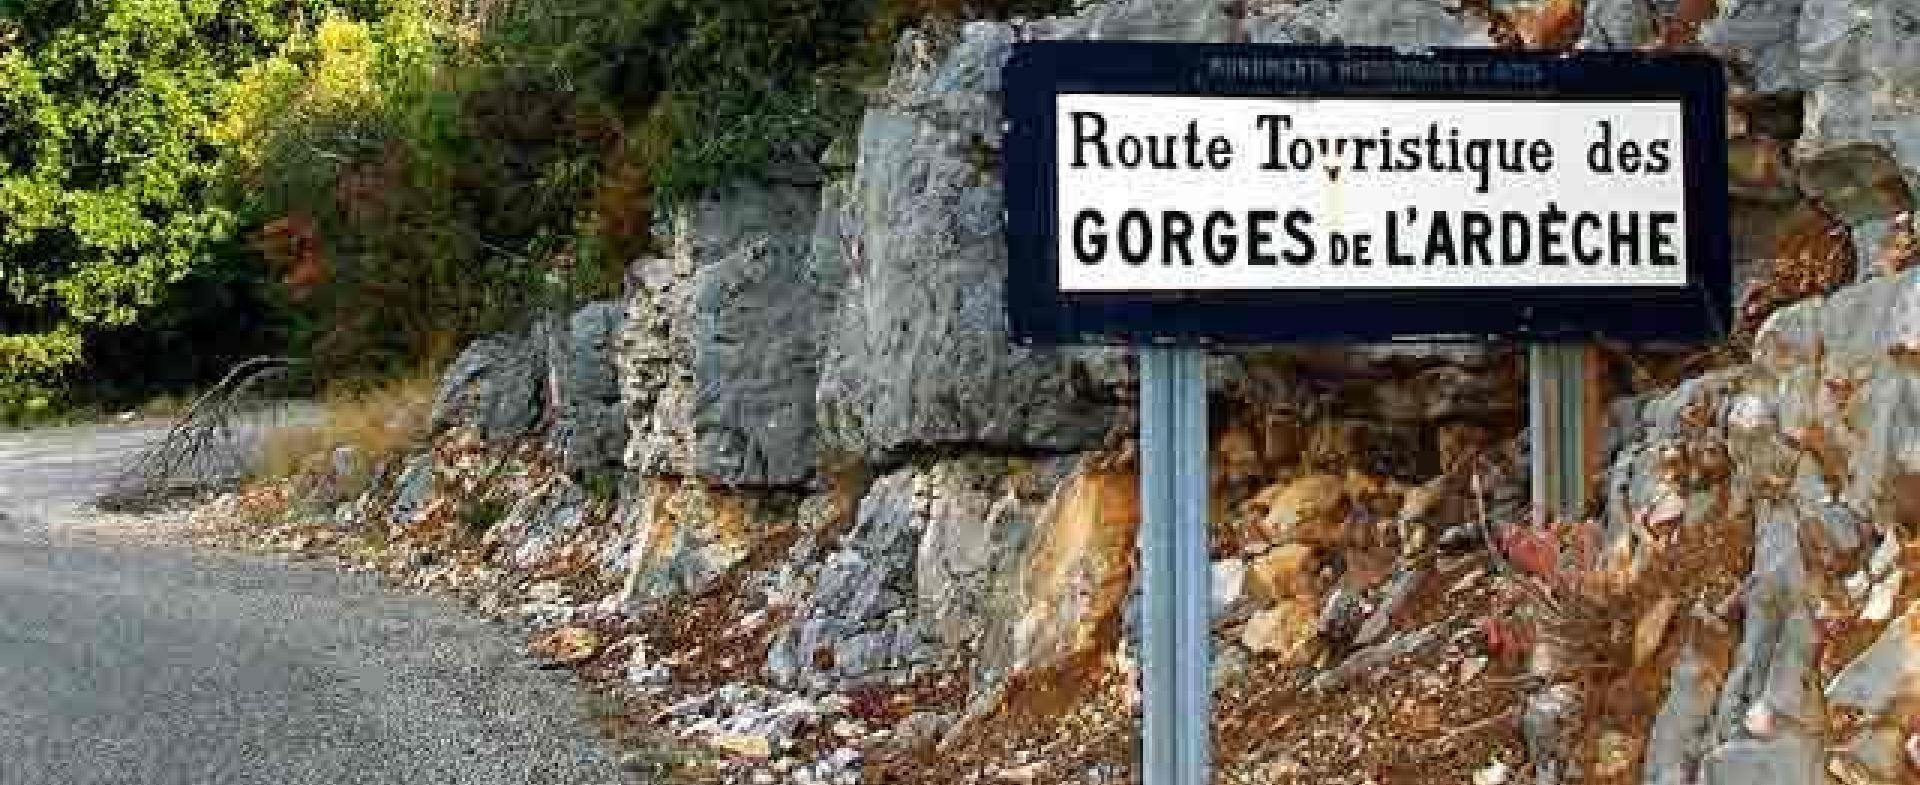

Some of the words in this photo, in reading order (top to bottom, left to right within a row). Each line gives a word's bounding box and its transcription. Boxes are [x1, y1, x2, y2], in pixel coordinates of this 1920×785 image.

[1071, 111, 1234, 170] Route
[1586, 120, 1671, 173] des
[1073, 209, 1316, 267] GORGES
[1328, 232, 1372, 267] DE
[1385, 202, 1679, 267] L'ARDÈCHE
